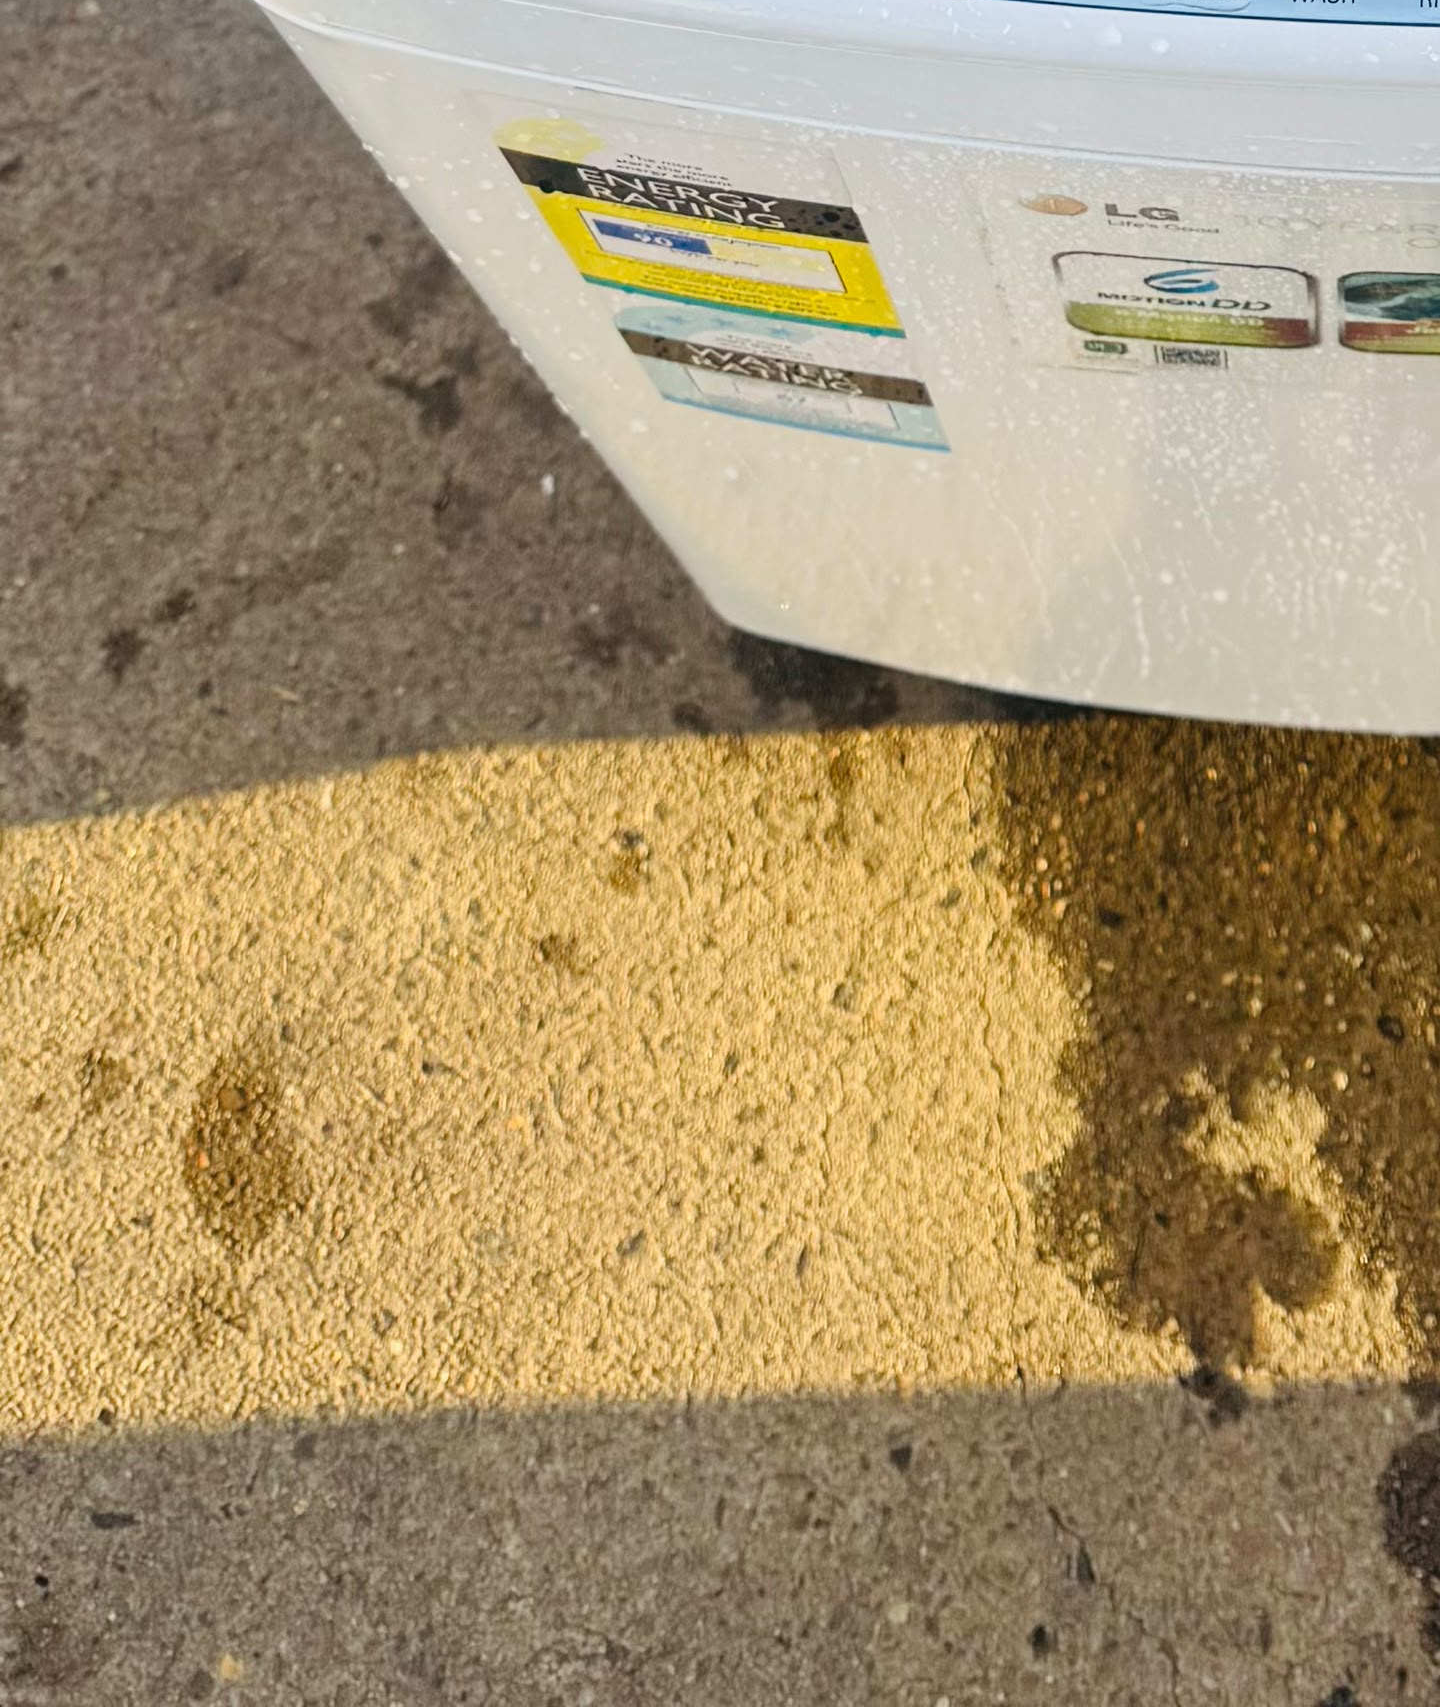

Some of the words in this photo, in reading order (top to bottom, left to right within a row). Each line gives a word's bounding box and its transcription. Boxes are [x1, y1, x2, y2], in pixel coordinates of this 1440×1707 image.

[576, 167, 779, 213] ENERGY
[585, 183, 786, 229] RATING
[1105, 203, 1180, 223] LG
[1108, 219, 1158, 231] Life's
[1164, 223, 1220, 235] Good
[1097, 292, 1206, 308] MOTION
[1211, 299, 1272, 311] DD
